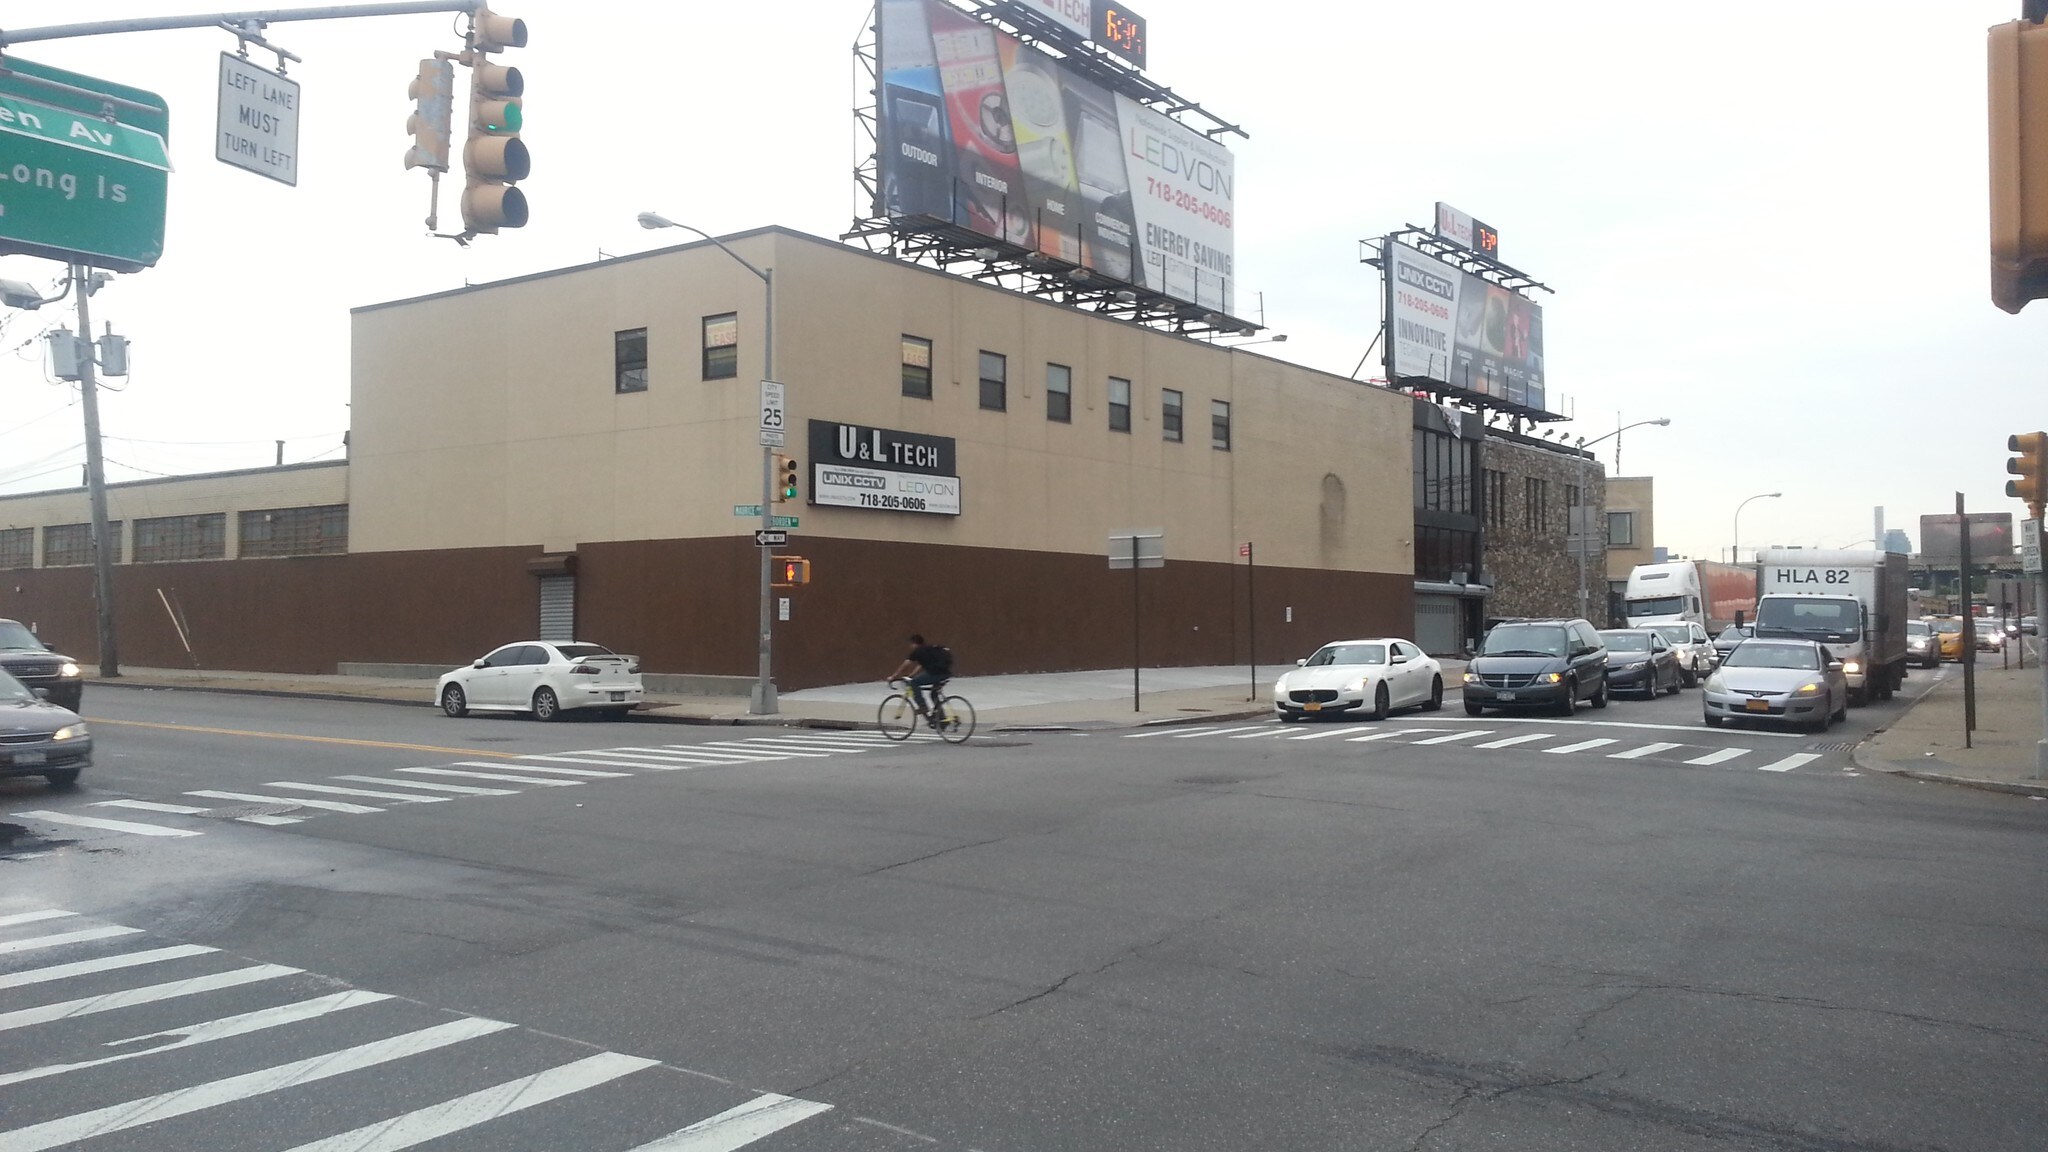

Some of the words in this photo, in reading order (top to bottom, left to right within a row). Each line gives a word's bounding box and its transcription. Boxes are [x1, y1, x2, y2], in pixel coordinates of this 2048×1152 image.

[228, 69, 257, 95] LEFT
[263, 84, 293, 110] LANE
[239, 104, 280, 136] MUST
[69, 121, 113, 146] Av
[225, 132, 257, 158] TURN
[264, 146, 291, 170] LEFT
[902, 142, 938, 167] OUTDOOR
[1131, 127, 1231, 201] LEDVON
[98, 175, 127, 202] Is
[976, 171, 1008, 194] INTERIOR
[1147, 176, 1231, 229] 718-205-0606
[1146, 222, 1190, 260] ENERGY
[1194, 242, 1231, 277] SAVING
[1147, 249, 1161, 267] LED
[1399, 264, 1425, 287] UNIX
[1425, 276, 1453, 297] CCTV
[1398, 317, 1446, 352] INNOVATIVE
[764, 408, 782, 426] 25
[891, 442, 937, 468] TECH
[823, 473, 852, 485] UNIX
[853, 476, 884, 488] CCTV
[899, 480, 954, 496] LEDVON
[860, 493, 926, 510] 718-205-0606
[1777, 569, 1819, 584] HLA
[1825, 569, 1850, 584] 82
